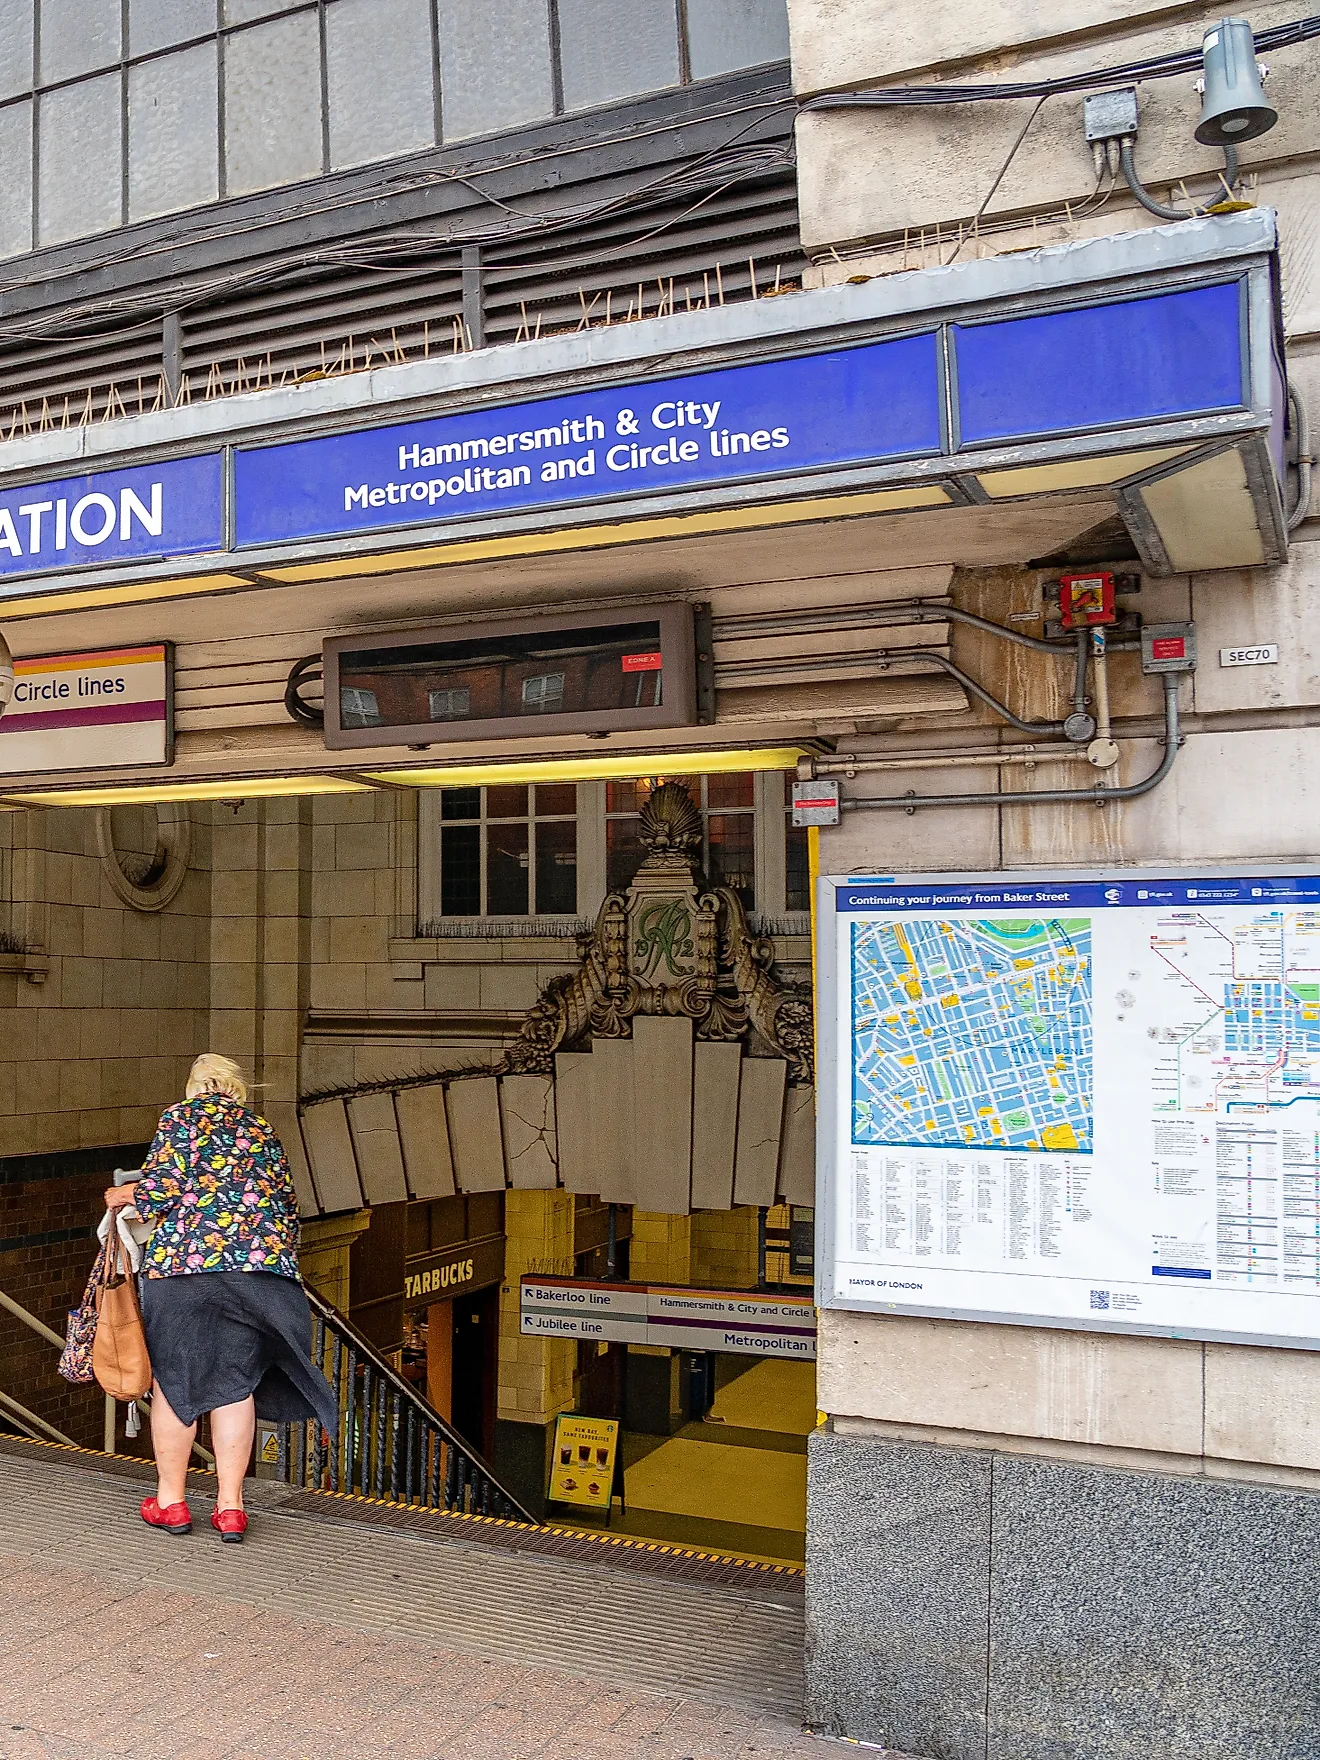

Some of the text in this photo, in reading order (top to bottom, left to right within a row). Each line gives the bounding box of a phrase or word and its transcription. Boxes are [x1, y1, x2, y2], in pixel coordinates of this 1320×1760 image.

[399, 400, 722, 471] Hammersmith & City
[344, 427, 789, 511] Metropolitan and Circle lines
[1229, 649, 1270, 662] SEC70
[14, 674, 126, 702] Circle lines
[848, 892, 1070, 907] Continuing your journey from Baker Street
[1011, 1047, 1085, 1056] MARYLEBONE
[404, 1259, 474, 1299] TARBUCKS
[848, 1278, 875, 1287] MAYOR
[888, 1281, 923, 1290] LONDON
[536, 1289, 611, 1306] Bakerloo line
[660, 1298, 725, 1310] Hammersmith
[737, 1304, 758, 1315] City
[760, 1306, 778, 1314] and
[781, 1307, 810, 1317] Circle
[536, 1317, 603, 1333] Jubilee line
[724, 1333, 808, 1351] Metropolitan
